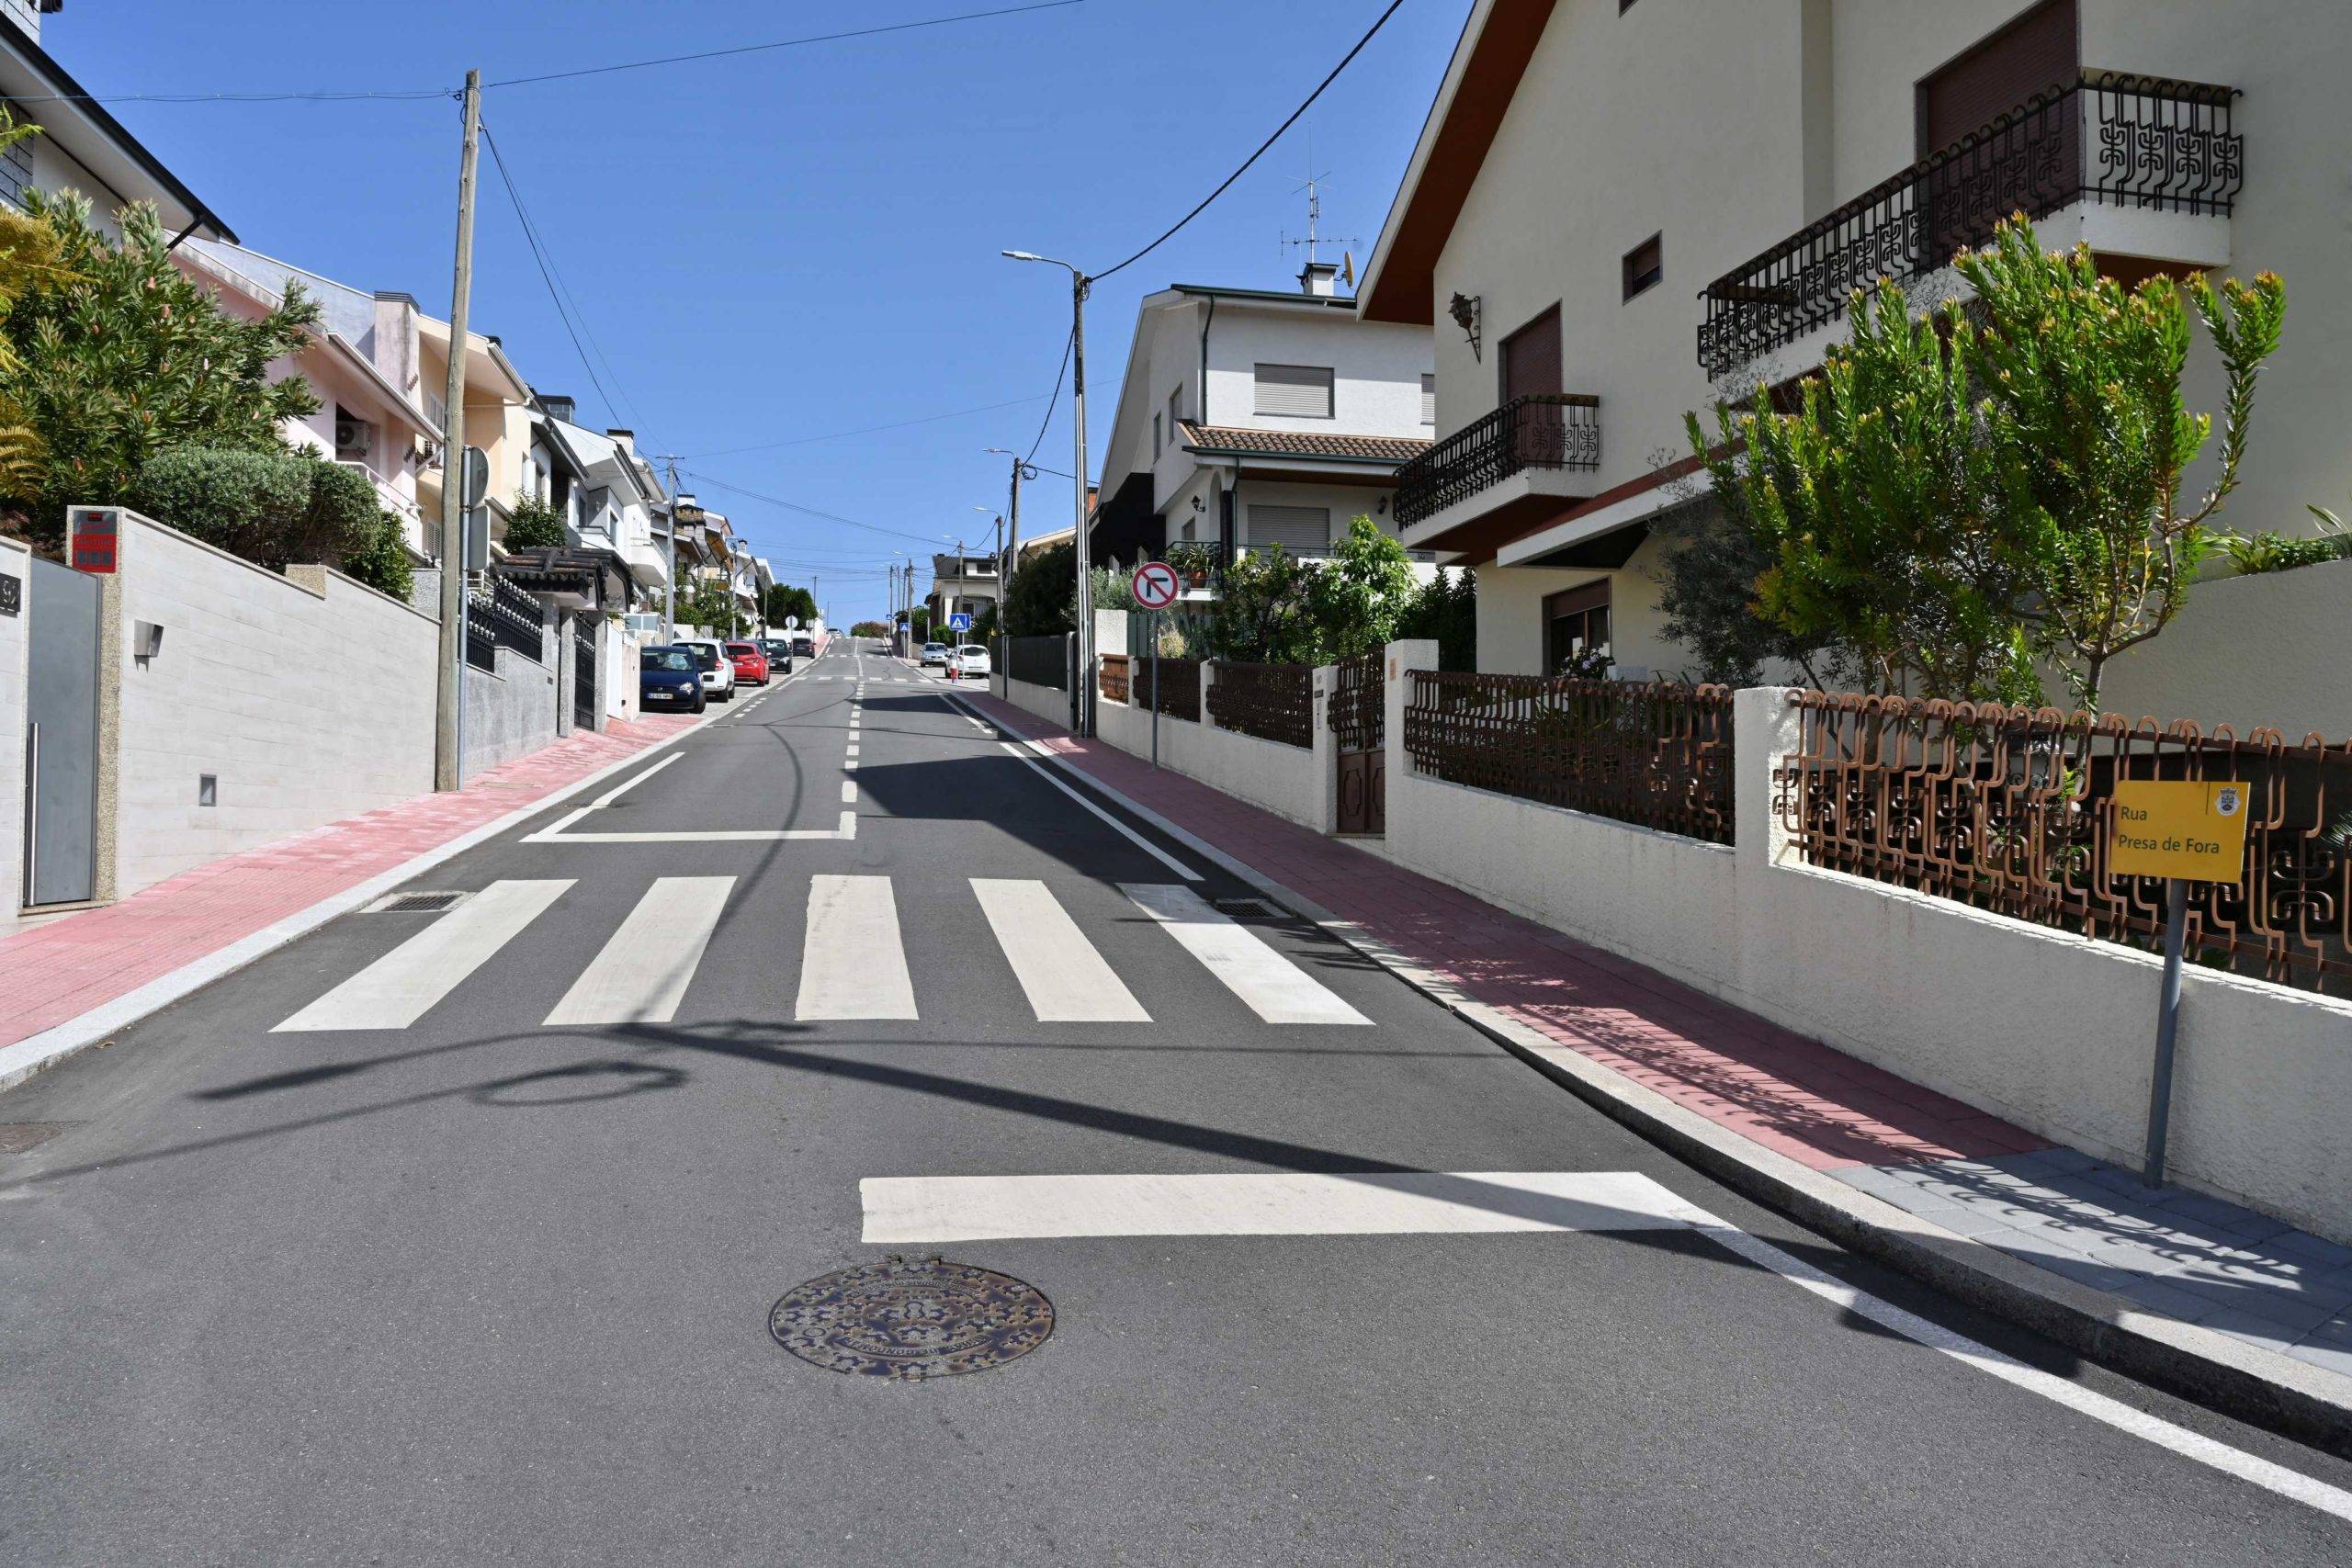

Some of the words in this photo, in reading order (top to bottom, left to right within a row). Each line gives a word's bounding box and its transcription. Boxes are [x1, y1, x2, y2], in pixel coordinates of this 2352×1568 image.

[2120, 807, 2148, 821] Rua
[2119, 834, 2157, 851] Presa
[2162, 837, 2181, 852] de
[2186, 838, 2220, 854] Fora
